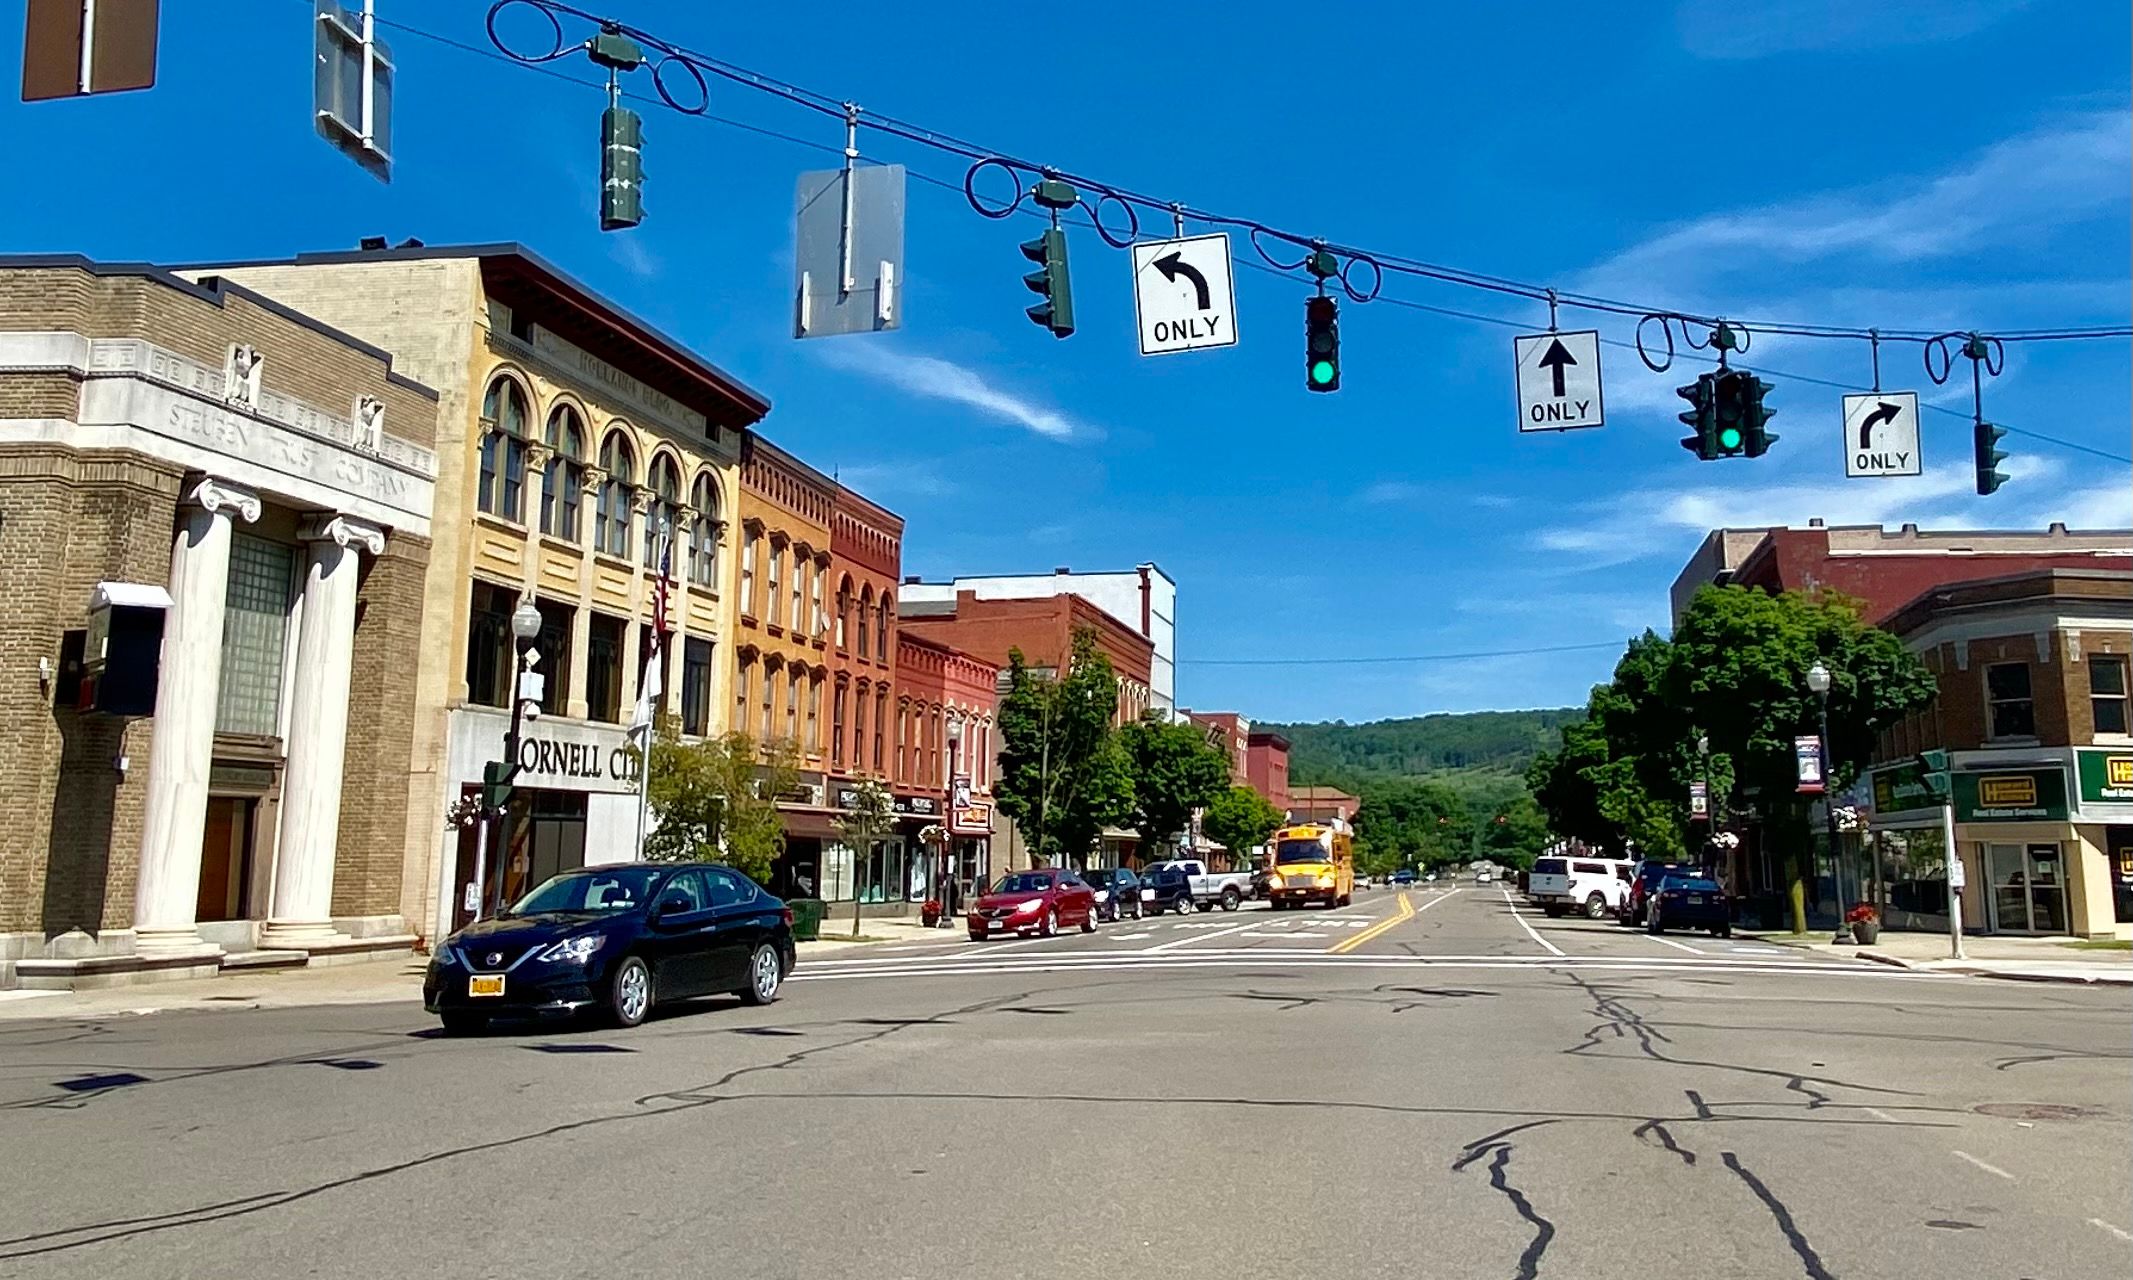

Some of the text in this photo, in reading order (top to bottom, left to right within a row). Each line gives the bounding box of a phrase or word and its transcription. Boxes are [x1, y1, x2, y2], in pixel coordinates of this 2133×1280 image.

[1154, 315, 1220, 342] ONLY
[1531, 400, 1590, 422] ONLY
[1856, 452, 1910, 469] ONLY
[519, 737, 642, 782] ORNELL CIT
